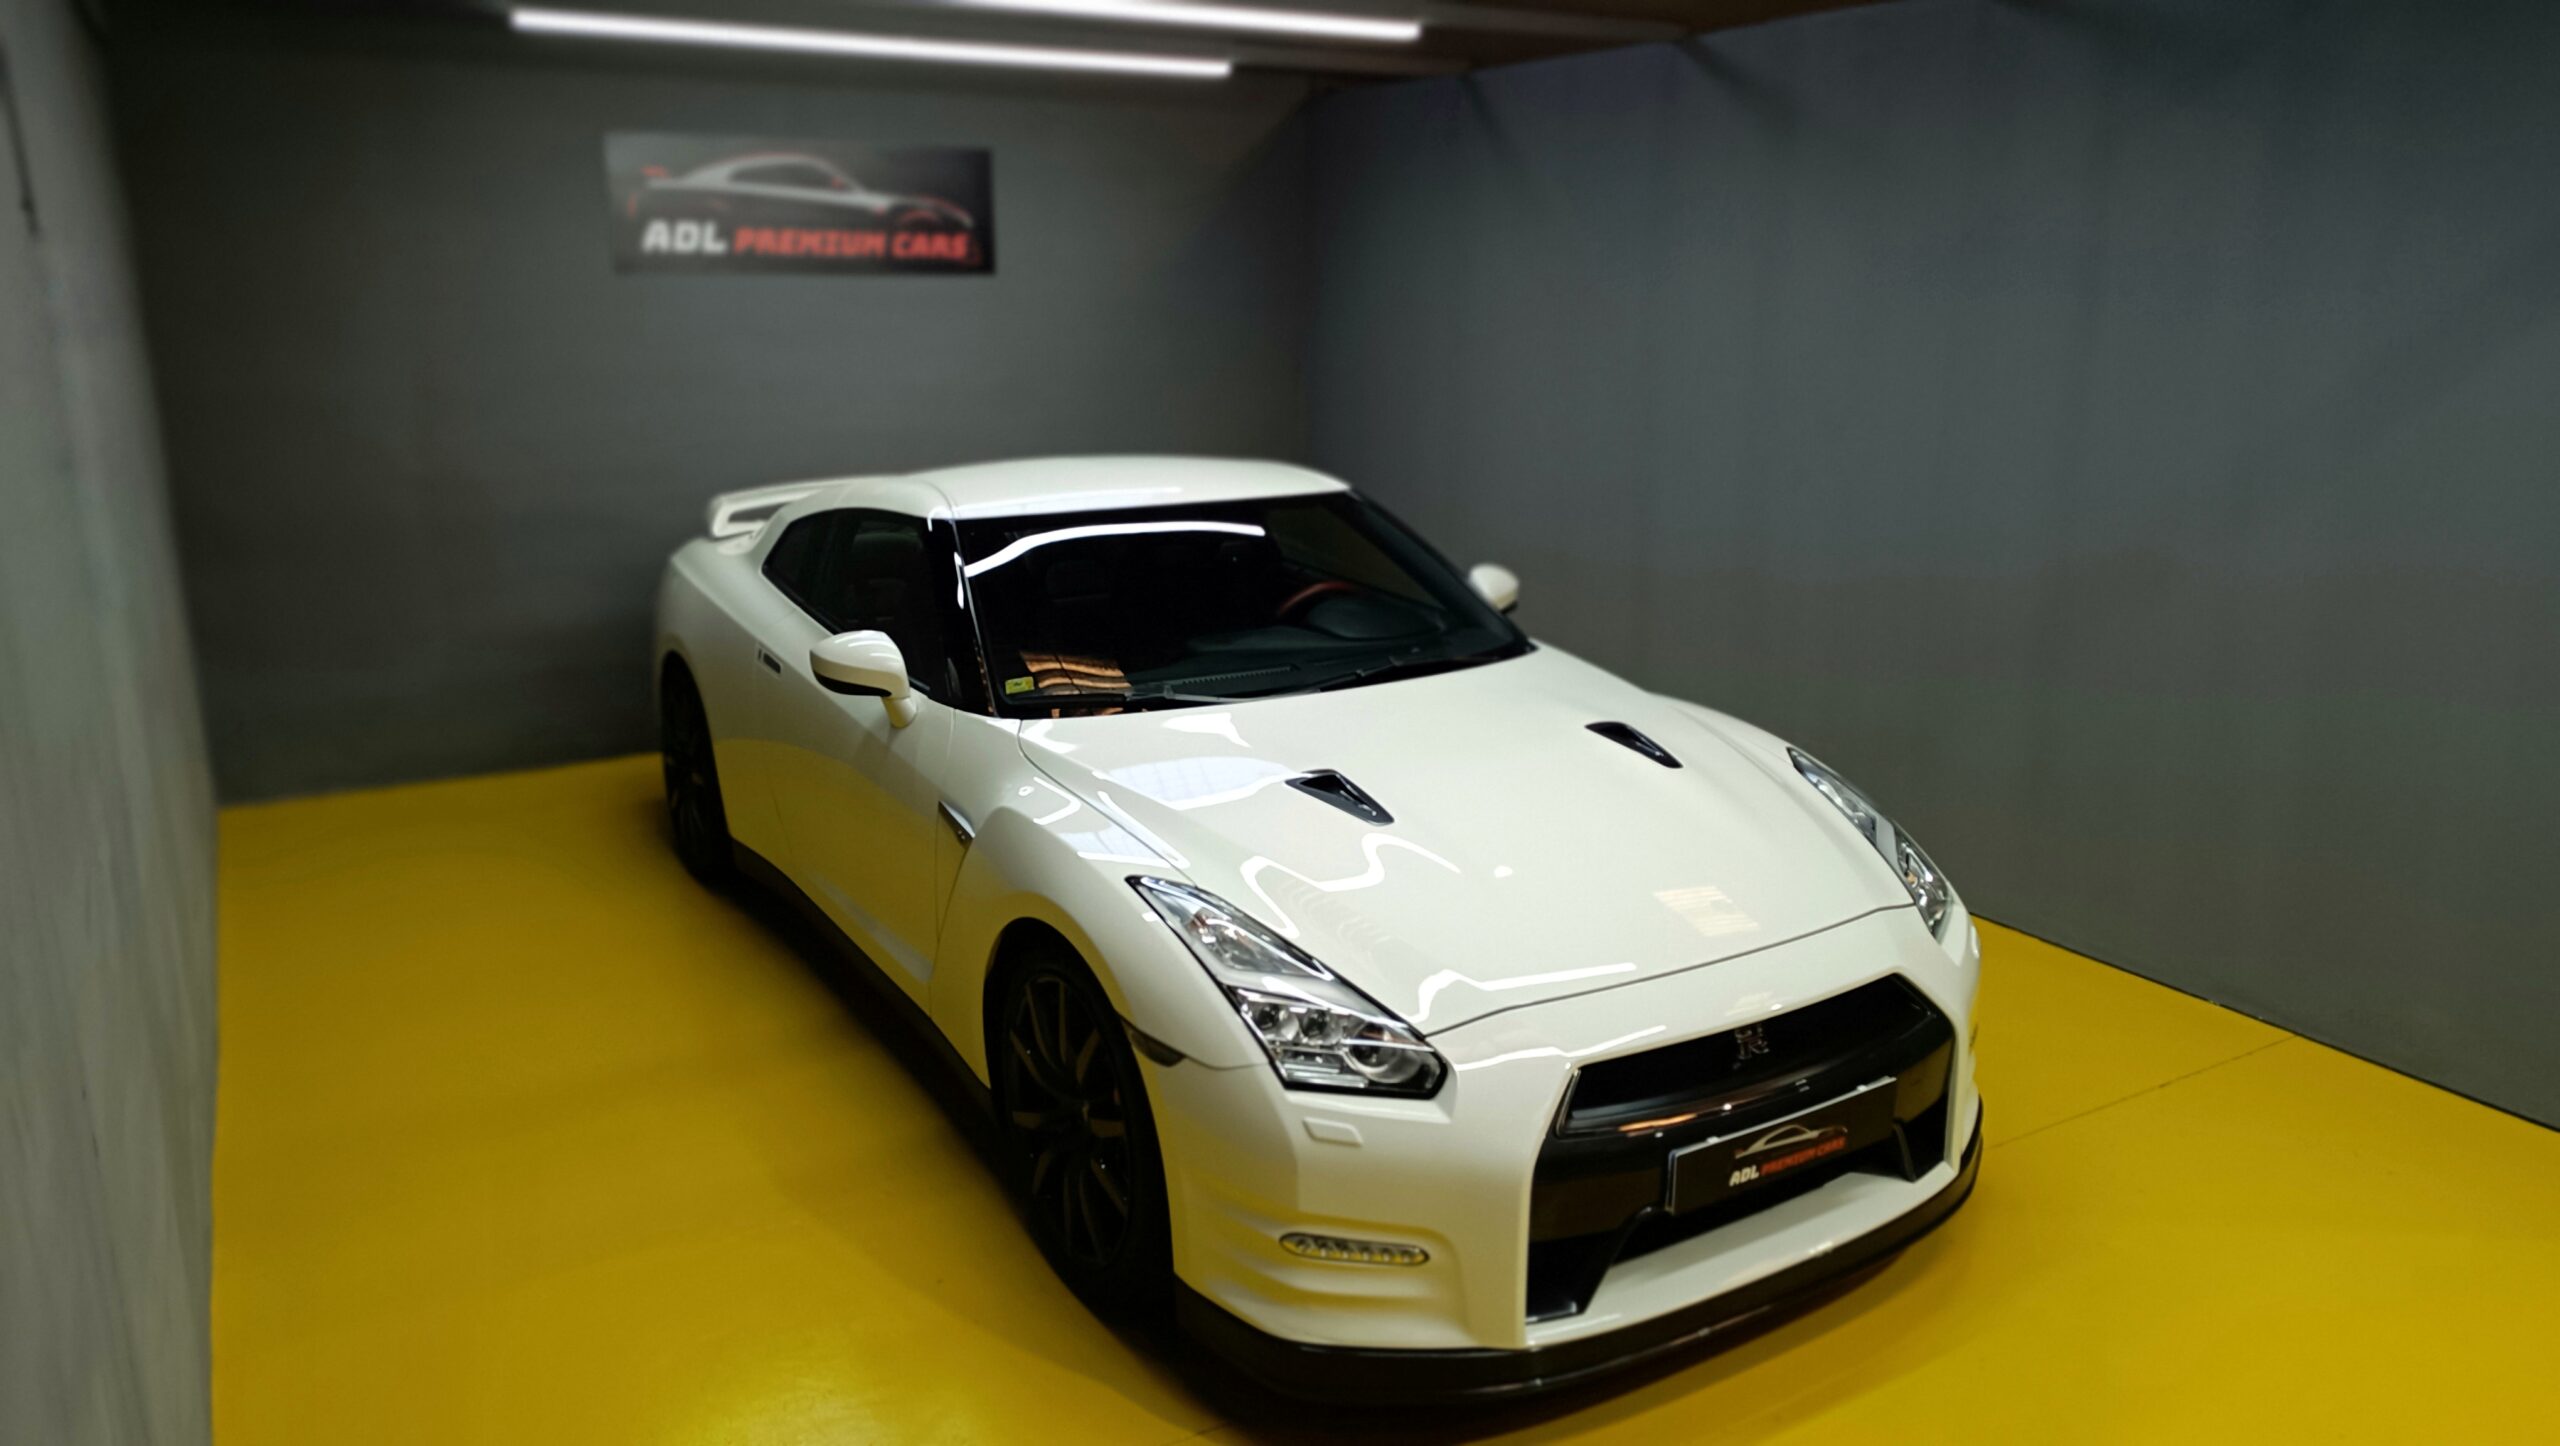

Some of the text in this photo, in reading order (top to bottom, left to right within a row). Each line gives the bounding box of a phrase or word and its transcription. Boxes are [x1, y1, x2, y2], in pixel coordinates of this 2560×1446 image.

[642, 218, 968, 260] ADL PREMIUM CARS
[1729, 1165, 1760, 1187] ADL
